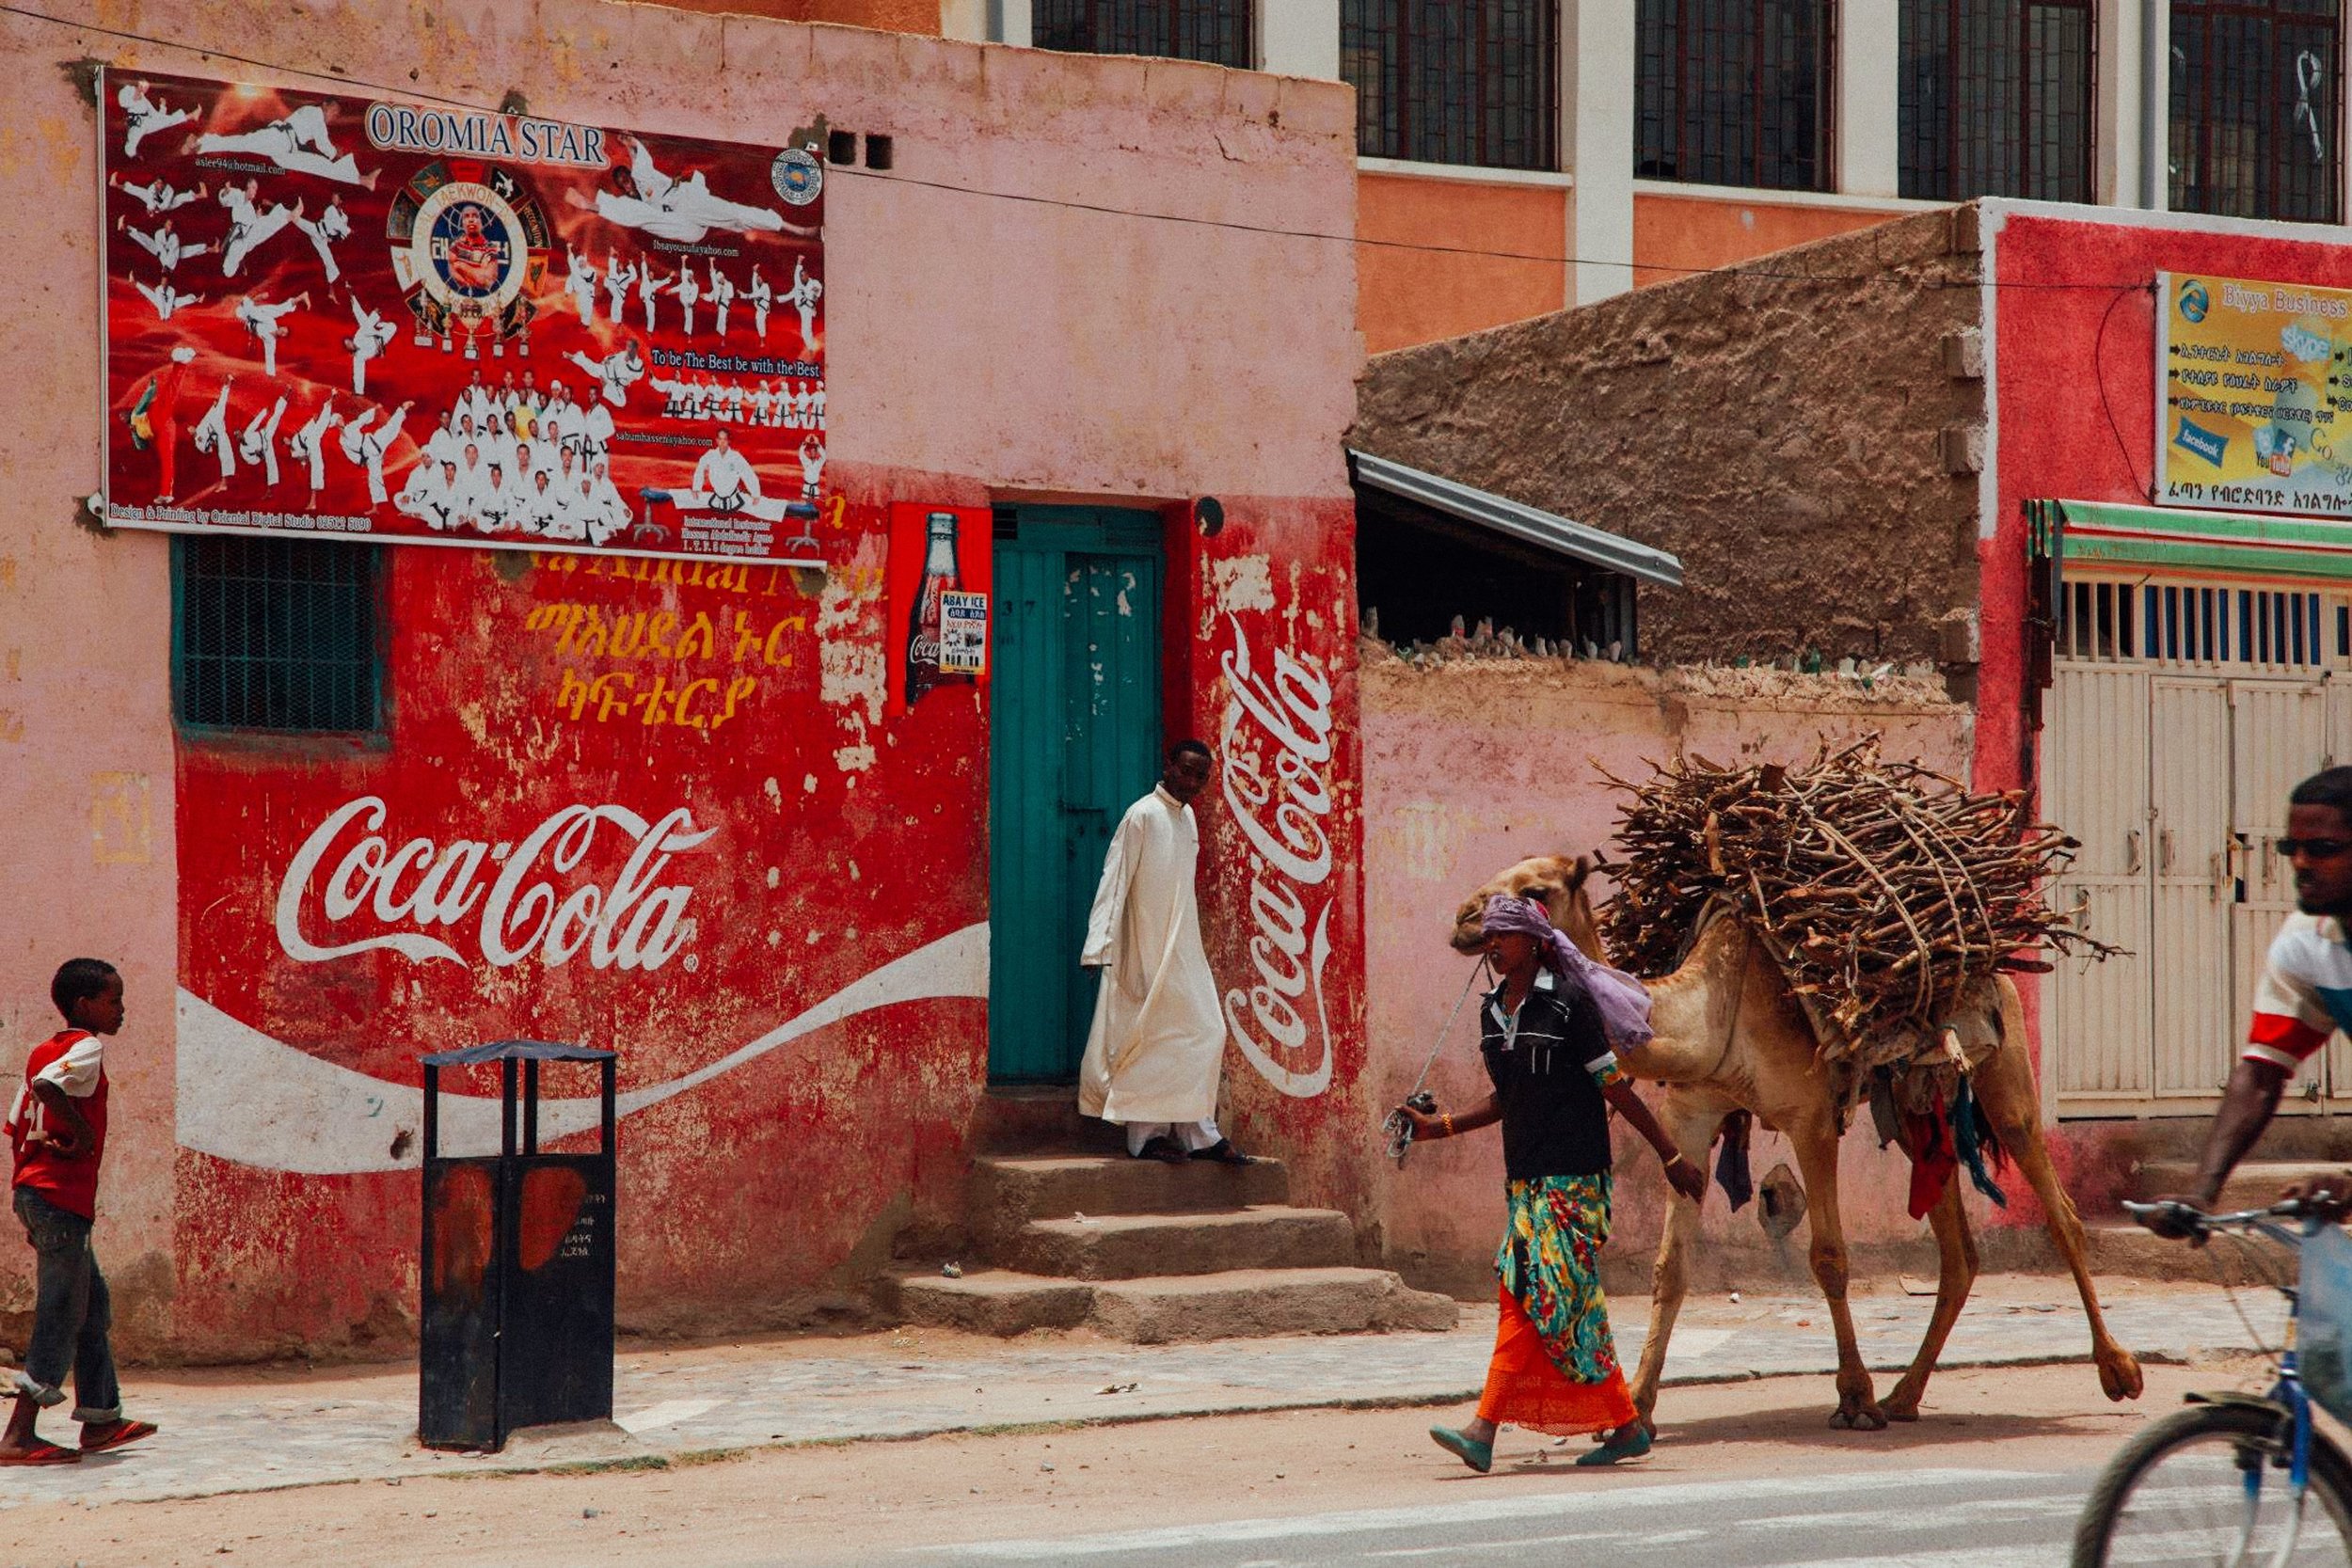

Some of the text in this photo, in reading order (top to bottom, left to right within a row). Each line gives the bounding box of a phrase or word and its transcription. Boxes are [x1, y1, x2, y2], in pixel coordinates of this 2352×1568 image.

[371, 106, 605, 165] OROMIA STAR
[2275, 290, 2347, 318] Business
[652, 349, 820, 377] To be The Best be with the Best
[2182, 428, 2219, 458] facebook
[110, 502, 145, 521] Design
[156, 506, 196, 524] Printing
[211, 509, 249, 525] Oriental
[251, 511, 282, 529] Digital
[284, 513, 315, 529] Studio
[943, 594, 984, 608] ABAY ICE
[1221, 610, 1333, 1099] Coca-Cola
[276, 796, 719, 972] Coca-Cola
